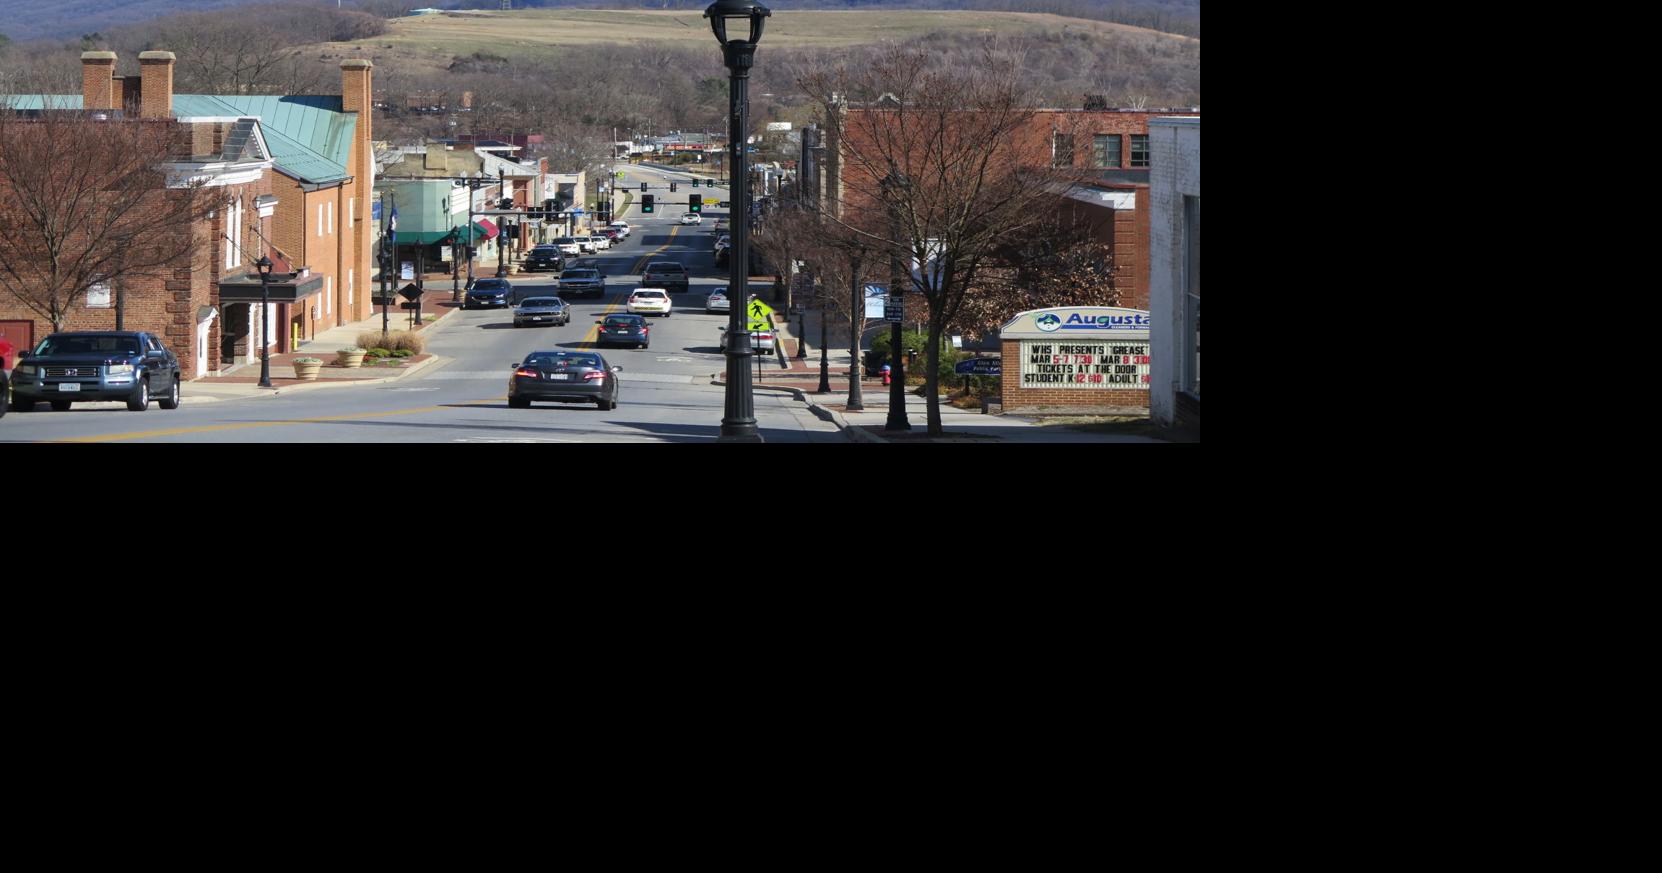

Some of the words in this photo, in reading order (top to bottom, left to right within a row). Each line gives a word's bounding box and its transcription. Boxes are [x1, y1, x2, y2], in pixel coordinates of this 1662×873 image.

[1066, 313, 1150, 328] Augusta
[1032, 345, 1052, 354] WHS
[1060, 346, 1105, 354] PRESENTS
[1031, 355, 1050, 363] MAR
[1100, 355, 1120, 364] MAR
[1123, 355, 1130, 364] 8
[1038, 365, 1074, 373] TICKETS
[1078, 365, 1090, 373] AT
[1095, 365, 1111, 373] THE
[1115, 365, 1137, 373] DOOR
[1025, 374, 1065, 383] STUDENT
[1109, 375, 1138, 383] ADULT
